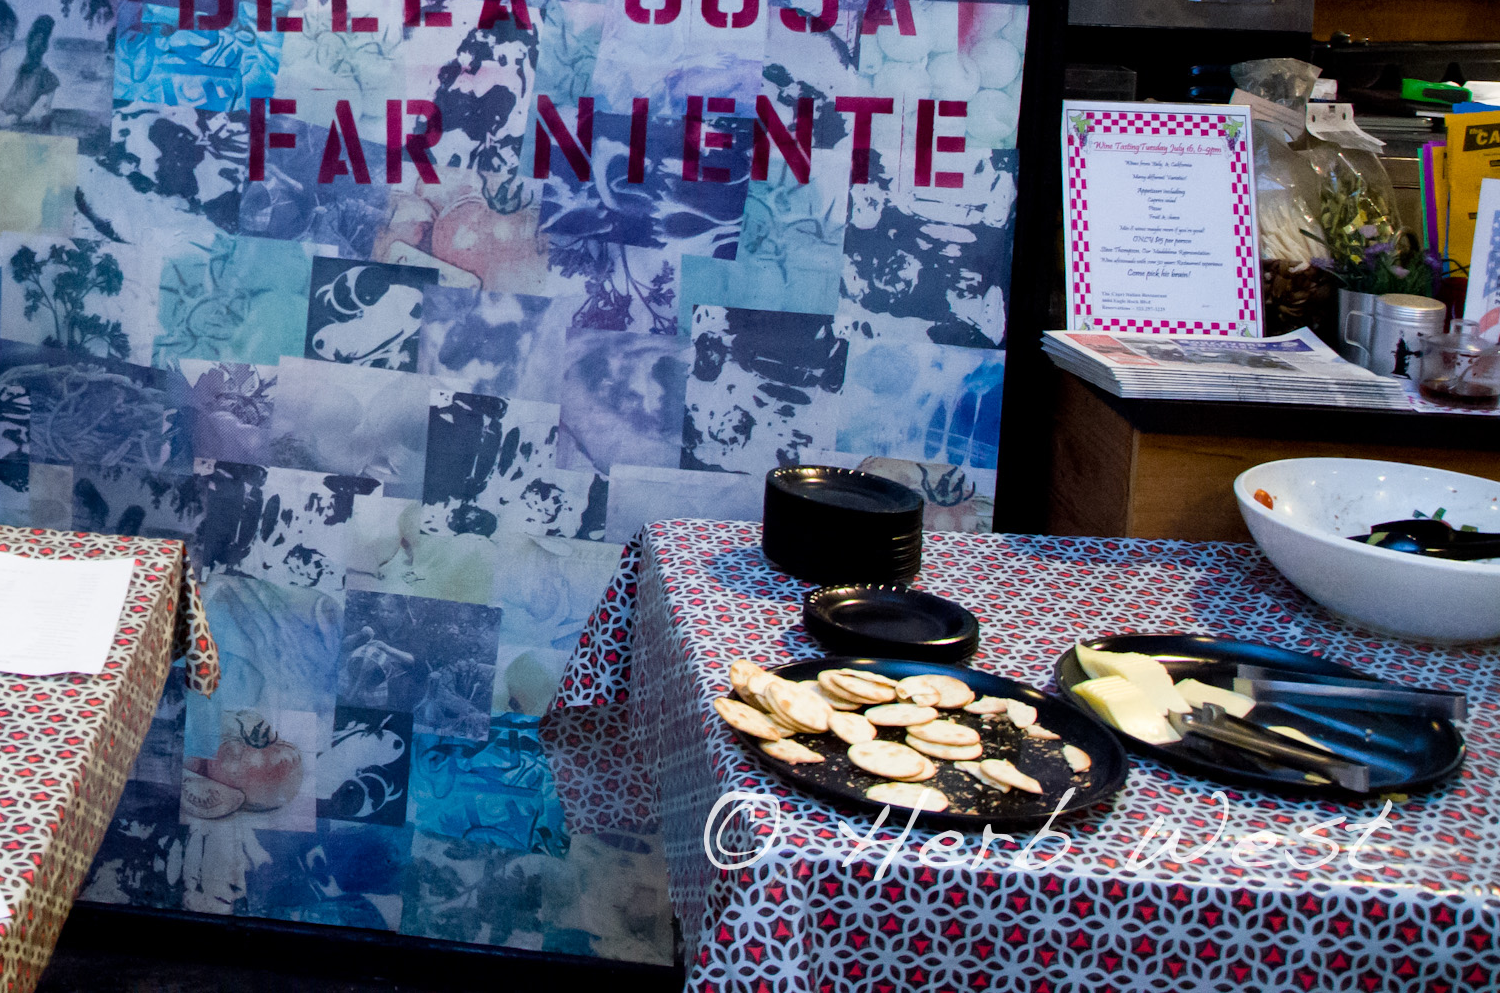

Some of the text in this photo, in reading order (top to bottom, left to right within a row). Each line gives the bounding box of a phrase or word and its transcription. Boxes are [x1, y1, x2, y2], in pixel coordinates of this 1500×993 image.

[249, 95, 969, 189] FAR NIENTE
[1093, 141, 1113, 150] Wine
[1115, 141, 1140, 154] Tasting
[1141, 142, 1168, 155] Tuesday
[1169, 143, 1185, 156] July
[1132, 235, 1155, 244] ONLY
[1163, 237, 1174, 246] per
[1127, 268, 1145, 277] Come
[1145, 269, 1160, 280] pick
[1170, 268, 1192, 278] brain!
